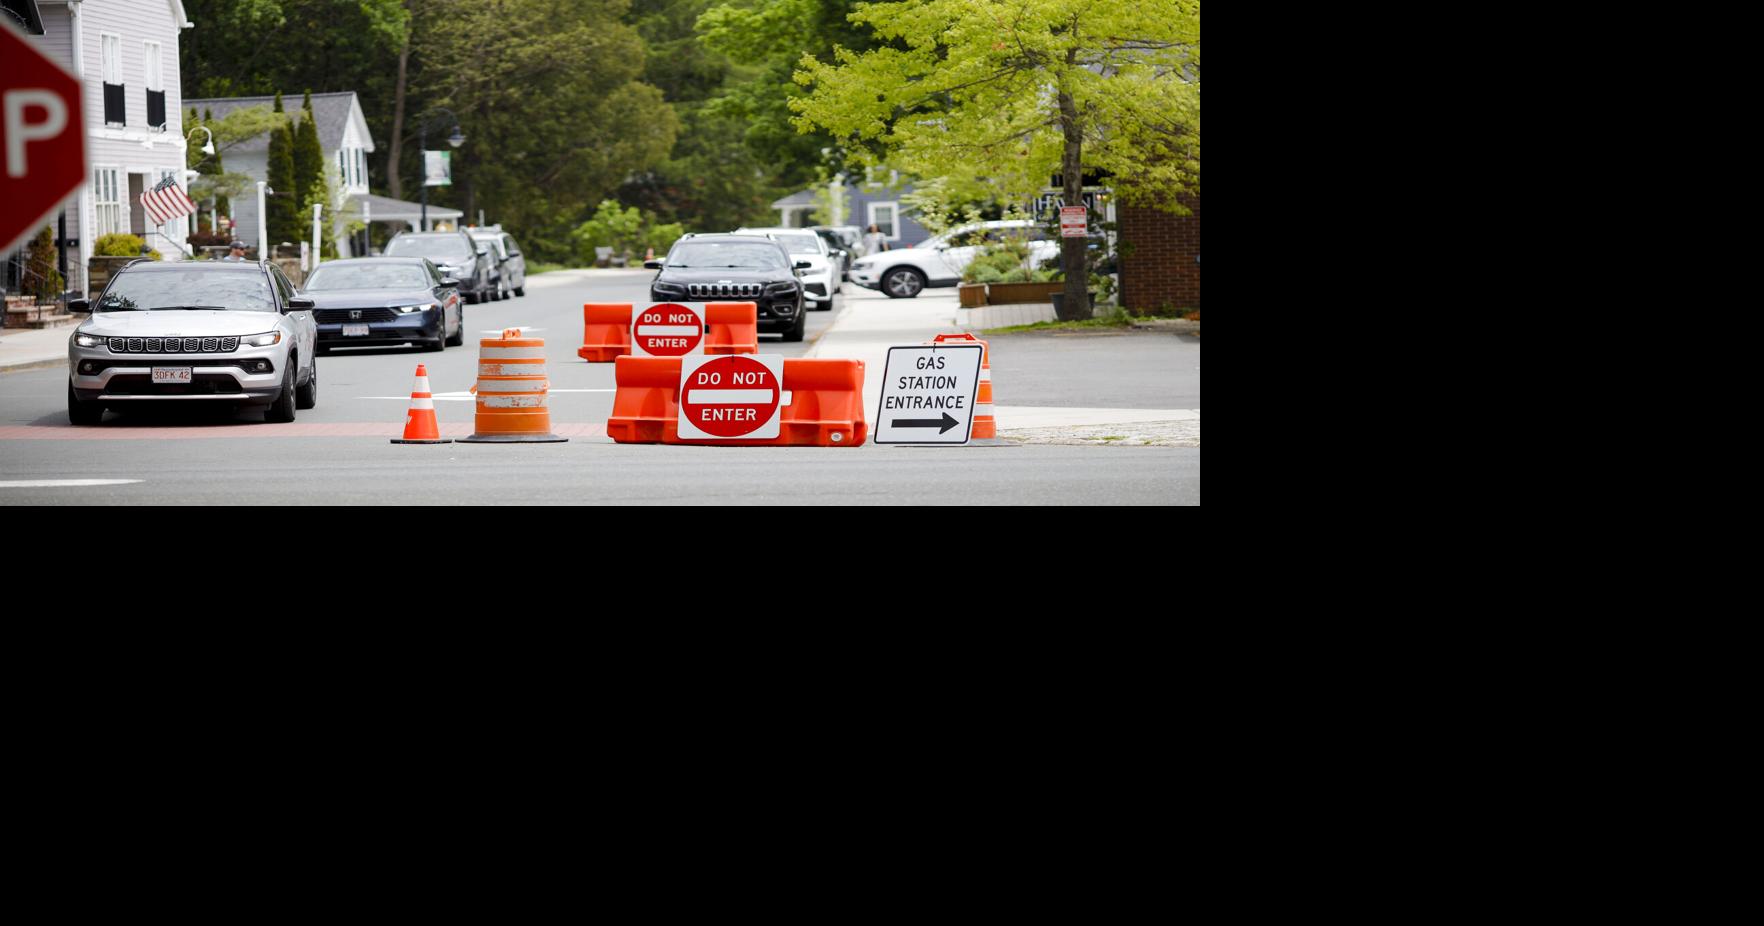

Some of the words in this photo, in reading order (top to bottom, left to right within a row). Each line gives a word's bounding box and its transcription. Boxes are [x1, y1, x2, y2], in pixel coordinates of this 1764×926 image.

[1038, 196, 1091, 209] HAN
[644, 313, 662, 323] DO
[668, 313, 694, 323] NOT
[648, 338, 688, 348] ENTER
[916, 356, 946, 370] GAS
[178, 371, 190, 380] 42
[697, 372, 721, 385] DO
[732, 372, 767, 385] NOT
[898, 376, 957, 390] STATION
[885, 395, 965, 410] ENTRANCE
[701, 408, 757, 421] ENTER
